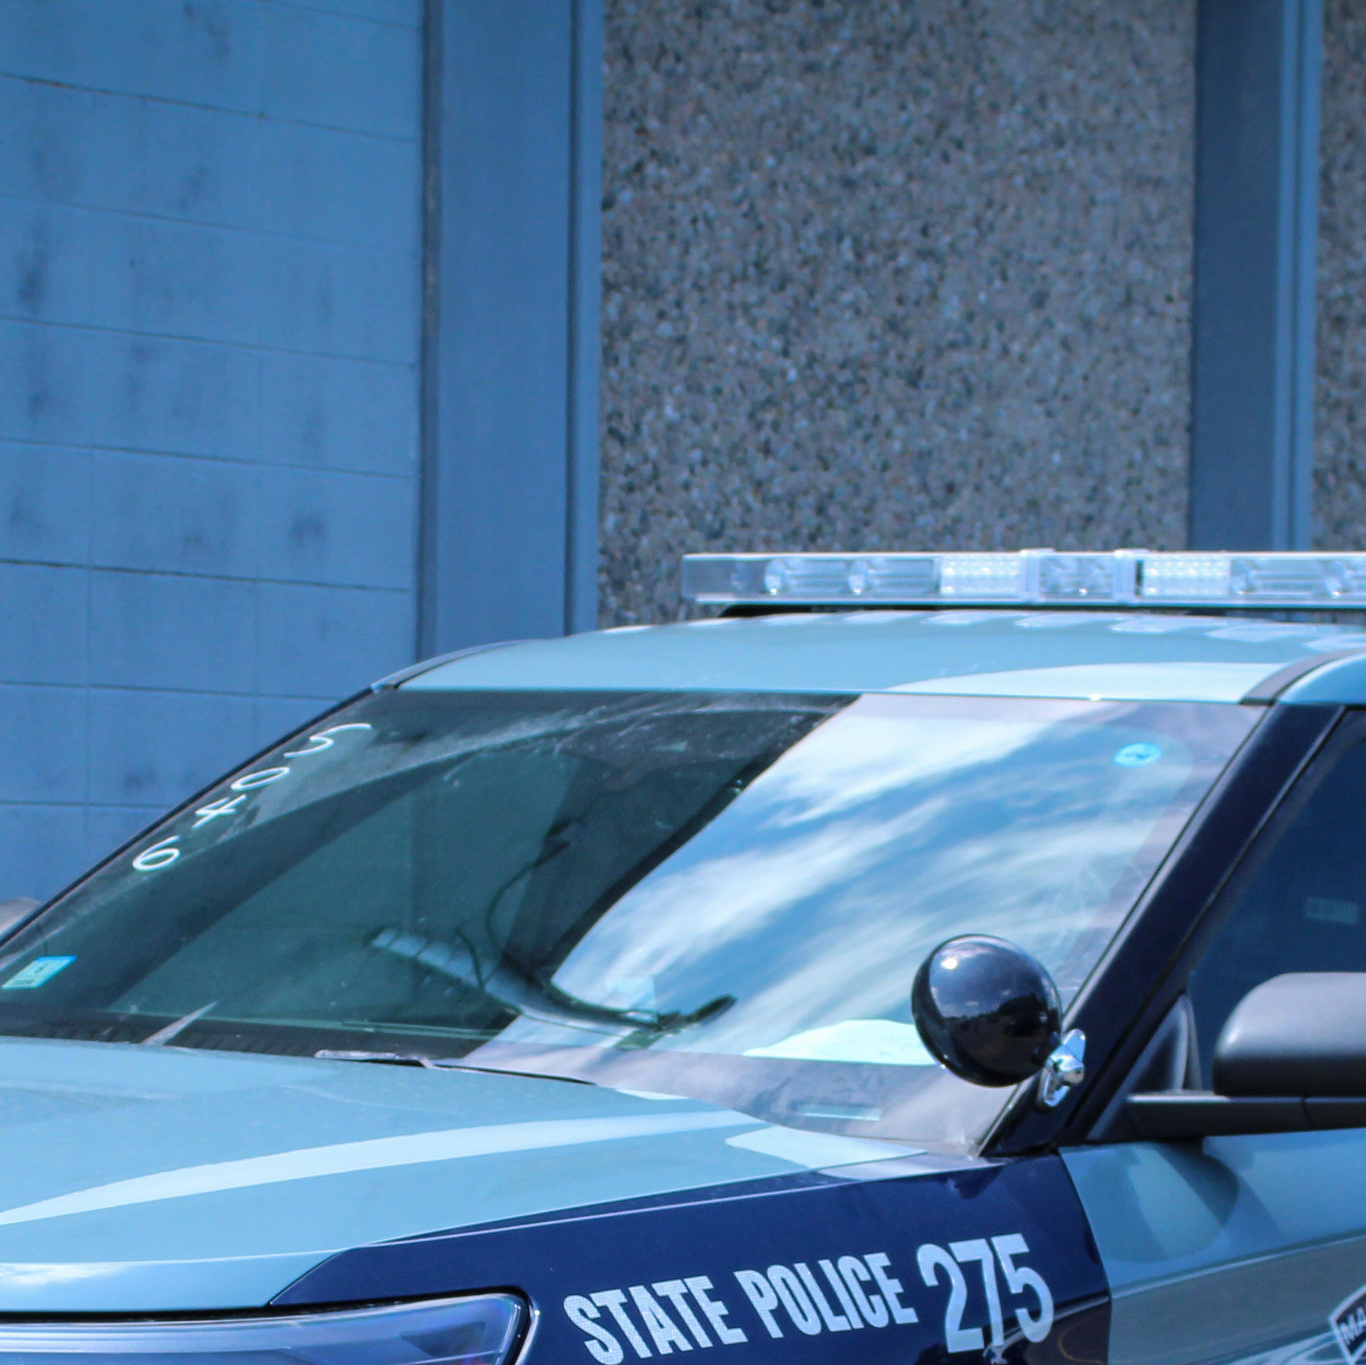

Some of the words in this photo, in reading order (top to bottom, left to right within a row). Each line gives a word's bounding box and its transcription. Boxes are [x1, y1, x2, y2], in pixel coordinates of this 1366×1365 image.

[563, 1275, 748, 1365] STATE
[734, 1252, 919, 1339] POLICE
[916, 1233, 1055, 1355] 275
